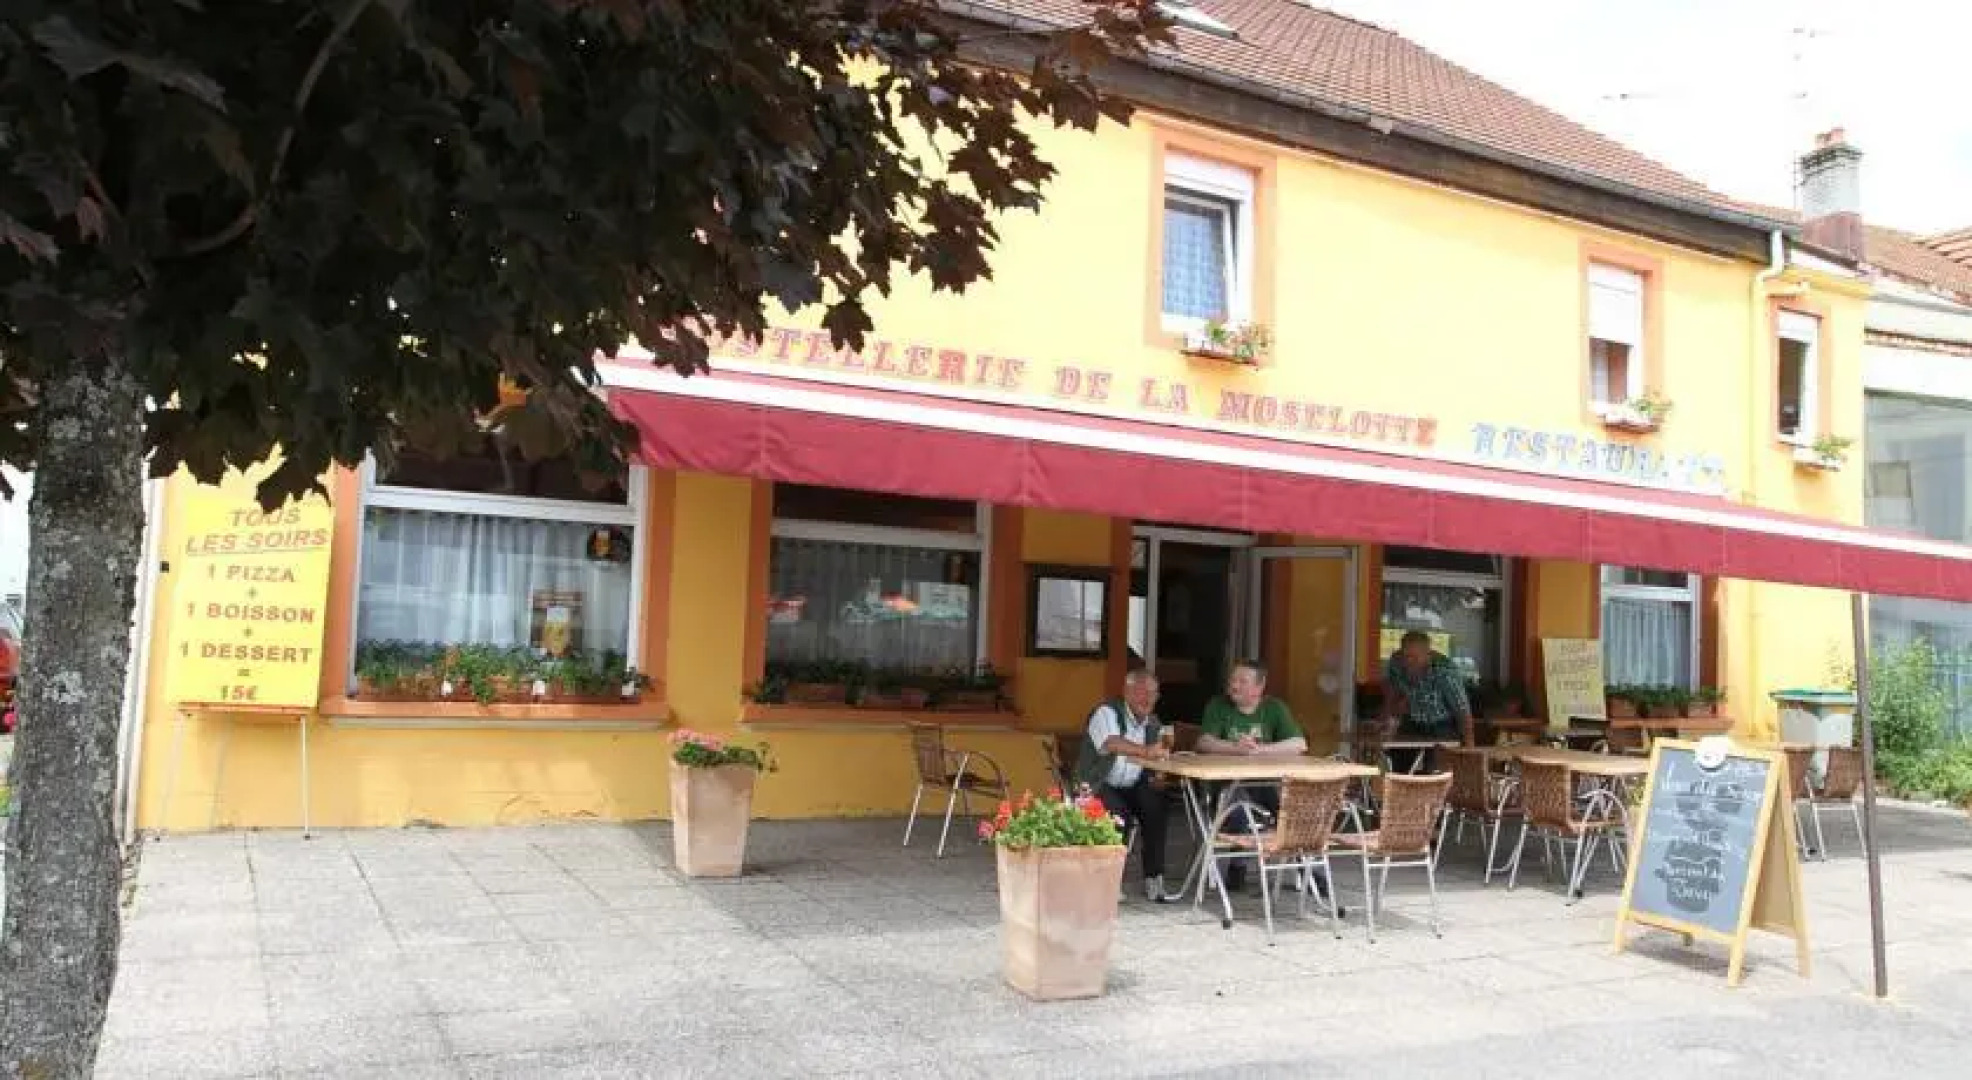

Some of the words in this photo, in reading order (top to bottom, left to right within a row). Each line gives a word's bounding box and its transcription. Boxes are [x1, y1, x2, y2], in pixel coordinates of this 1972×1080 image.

[1055, 366, 1112, 400] DE
[1138, 377, 1189, 413] LA
[1218, 388, 1439, 447] MOSELOTTE
[229, 507, 301, 527] TOUS
[186, 533, 238, 554] LES
[247, 528, 329, 548] SOIRS
[208, 563, 216, 579] 1
[227, 564, 295, 583] PIZZA
[187, 602, 196, 617] 1
[206, 602, 316, 623] BOISSON
[180, 640, 189, 657] 1
[201, 642, 313, 663] DESSERT
[220, 684, 259, 701] 15€
